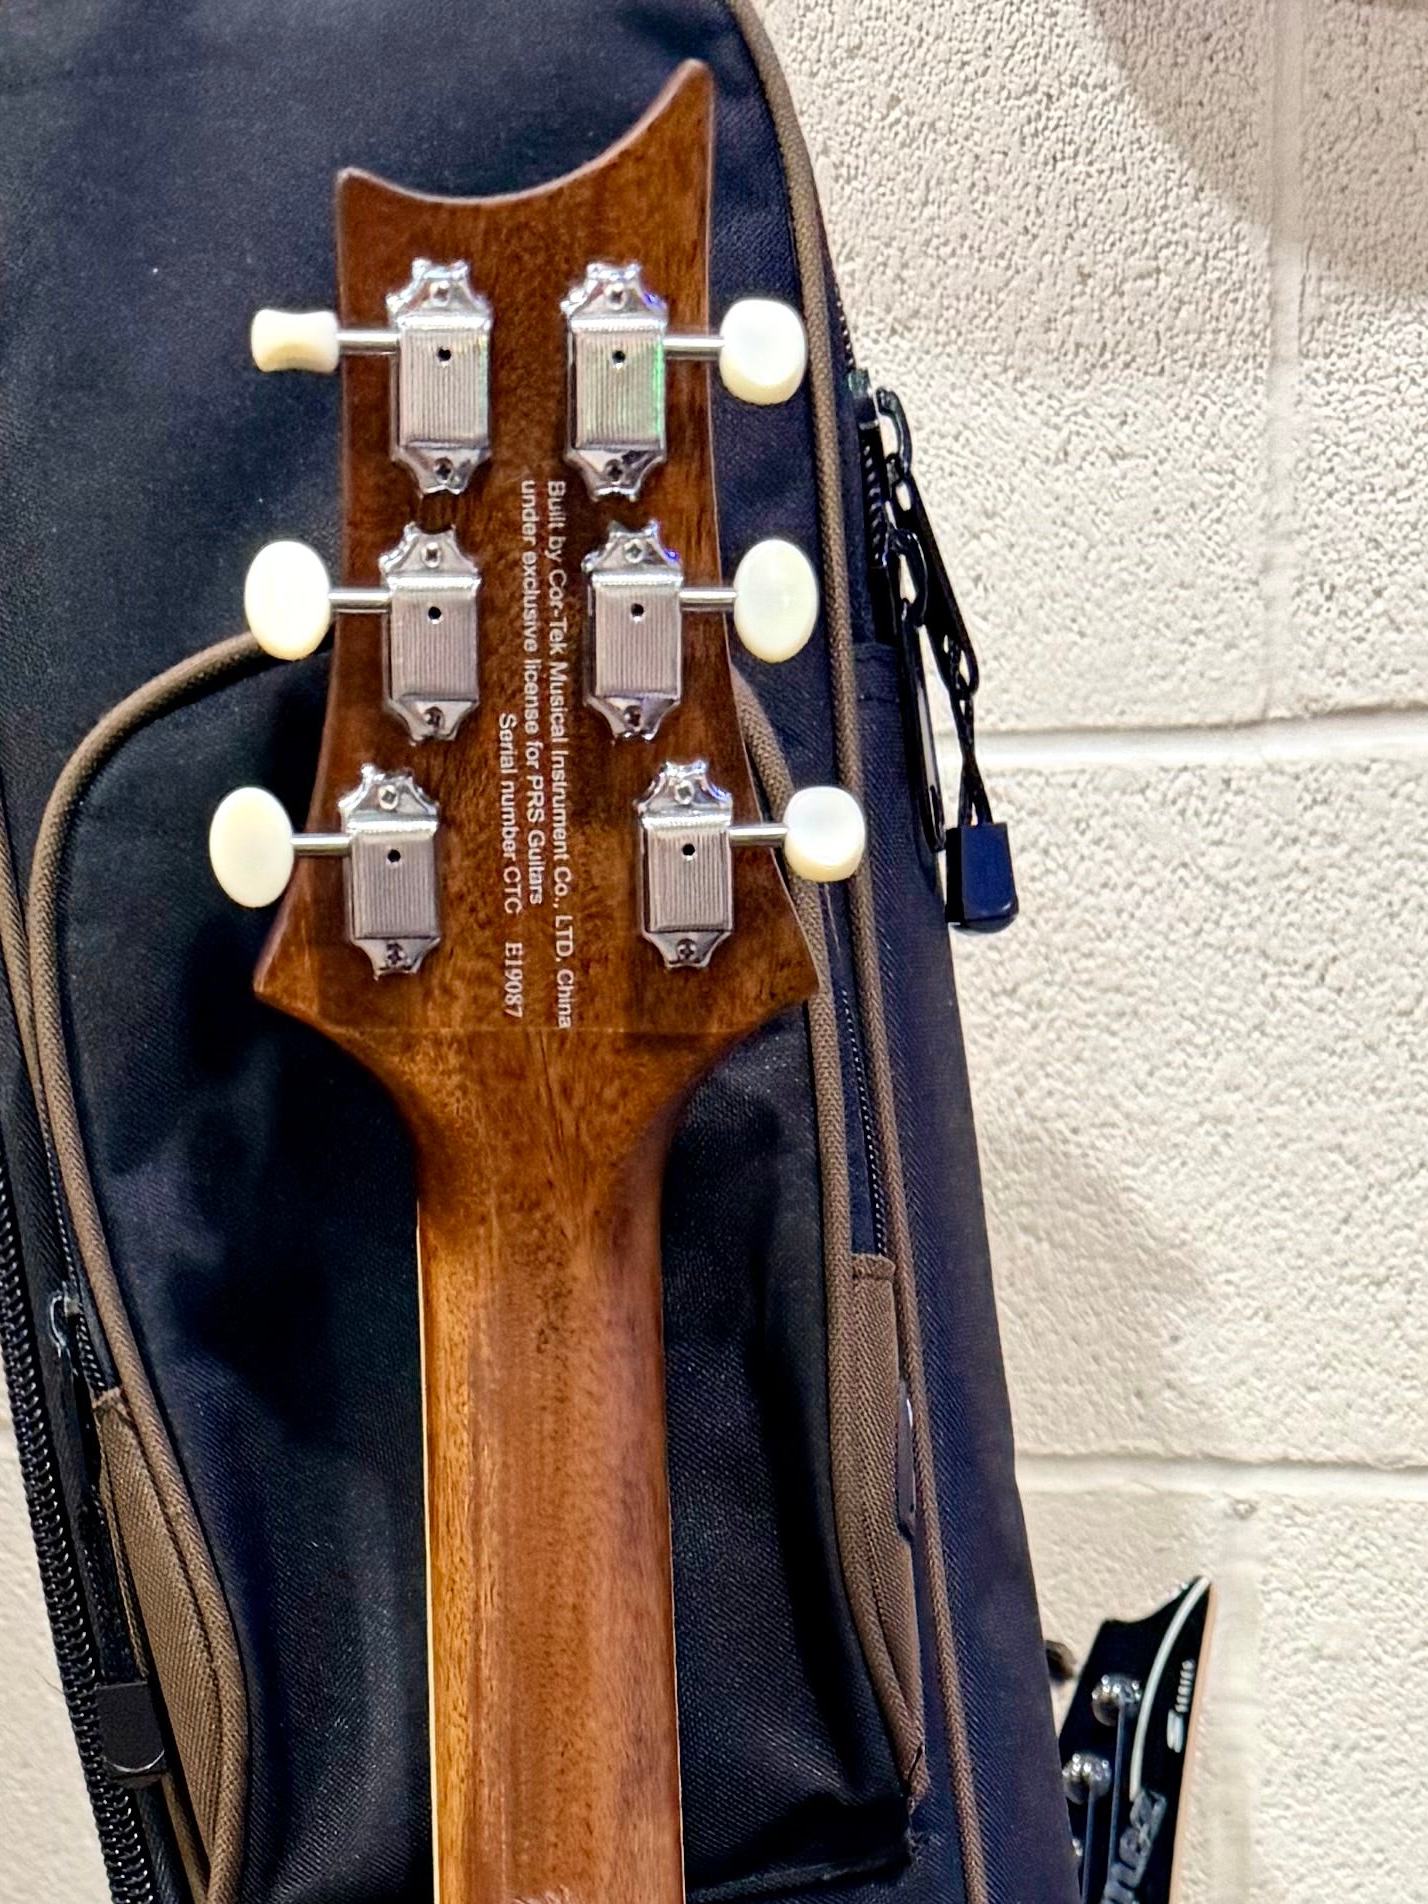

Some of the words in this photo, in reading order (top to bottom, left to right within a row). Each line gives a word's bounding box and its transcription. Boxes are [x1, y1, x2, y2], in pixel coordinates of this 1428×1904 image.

[522, 480, 540, 545] under
[548, 480, 566, 529] Built
[545, 532, 566, 561] by
[522, 552, 541, 652] exclusive
[548, 570, 568, 655] Cor-Tek
[524, 659, 542, 734] license
[550, 661, 569, 742] Musical
[499, 713, 518, 773] Serial
[525, 741, 544, 769] for
[501, 780, 519, 861] number
[526, 775, 544, 823] PRS
[551, 751, 570, 860] Instrument
[503, 866, 522, 914] CTC
[528, 830, 546, 905] Guitars
[557, 969, 574, 1029] China
